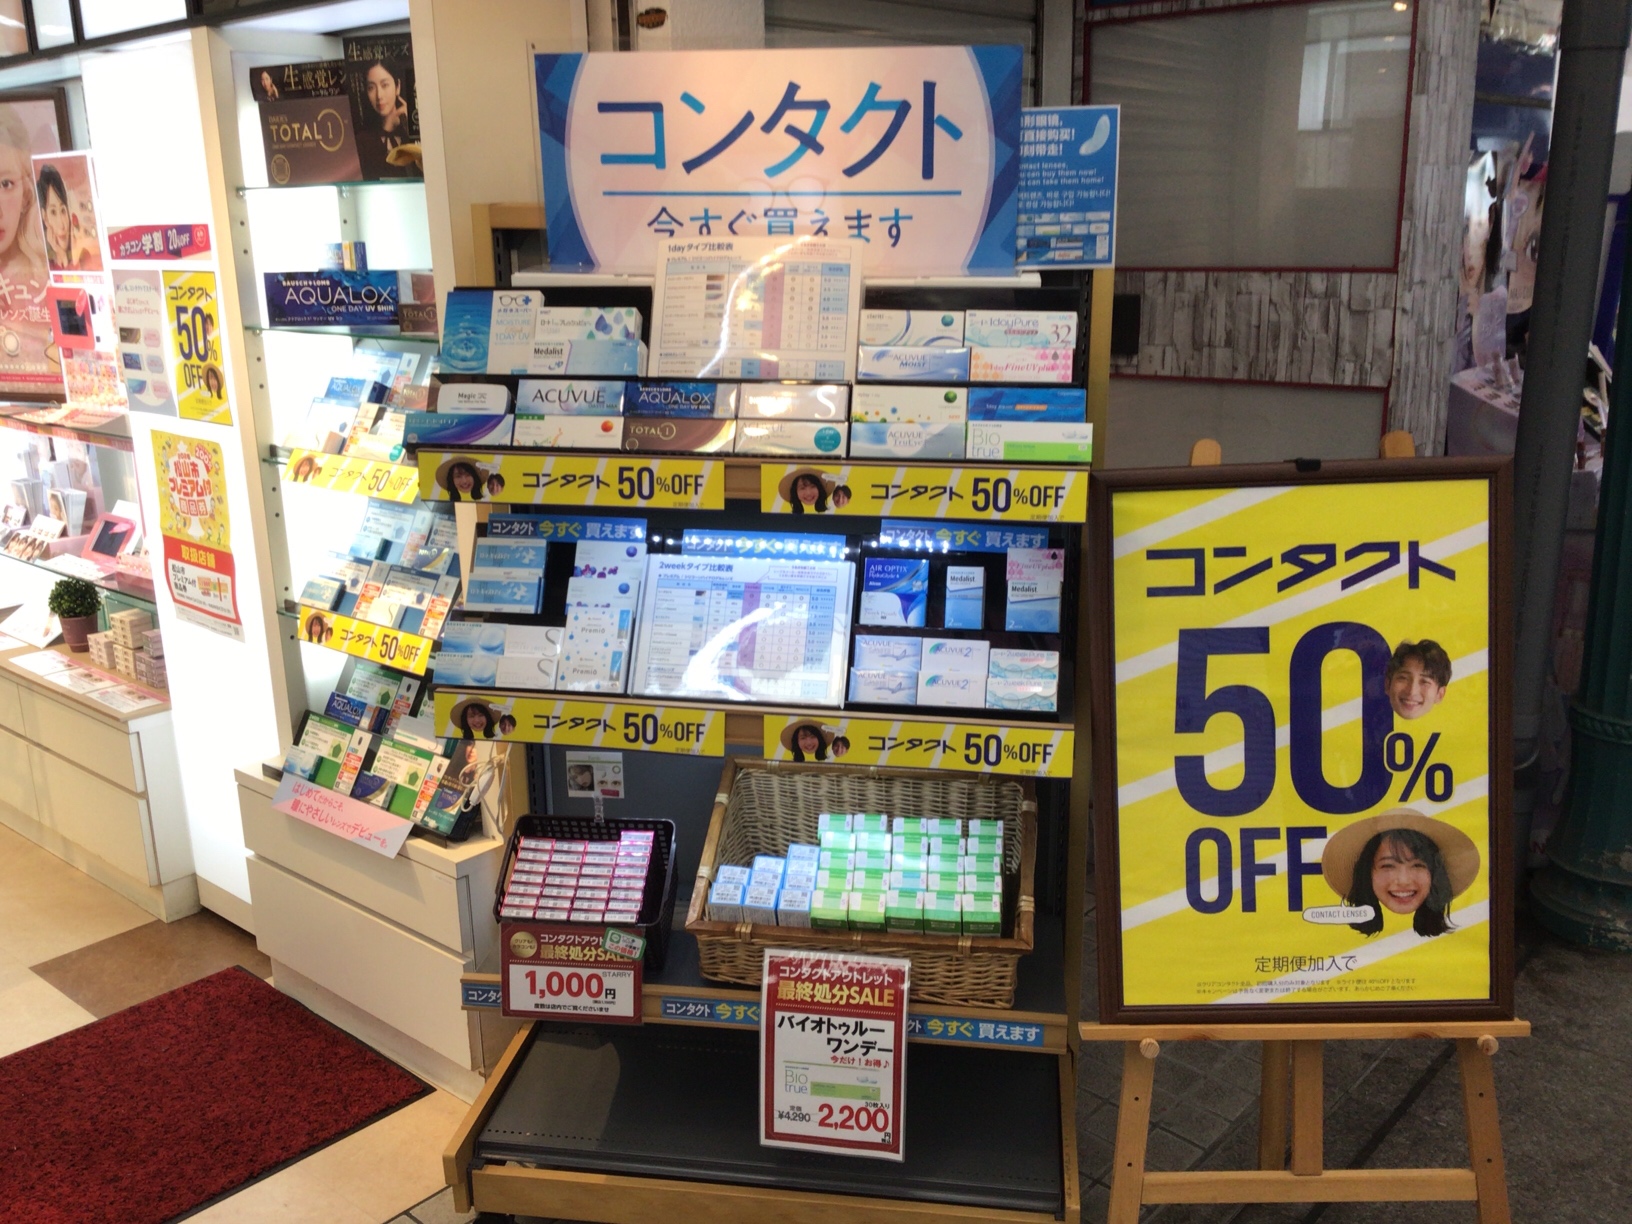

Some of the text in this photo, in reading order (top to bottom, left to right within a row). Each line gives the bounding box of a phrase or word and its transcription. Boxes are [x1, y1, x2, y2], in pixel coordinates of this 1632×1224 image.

[597, 80, 963, 181] コンタクト
[647, 205, 914, 248] 今すぐ買えます
[169, 286, 213, 301] コンタクト
[285, 286, 394, 305] AQUALOX
[331, 305, 394, 313] ONE DAY UV SHIN
[533, 347, 563, 356] Medalist
[458, 392, 476, 400] Magic
[532, 388, 605, 409] ACUVUE
[638, 392, 711, 404] AQUALOX
[972, 428, 1001, 445] Bio
[971, 445, 1000, 457] true
[174, 459, 200, 479] 松山市
[328, 466, 368, 482] コンタクト
[523, 471, 610, 490] コンタクト
[870, 483, 963, 501] コンタクト
[492, 521, 643, 540] コンタクト 今すぐ 買えます
[883, 528, 1046, 549] コンタクト 今すぐ 買えます
[181, 544, 216, 569] 取扱店舗
[869, 565, 907, 573] AIR OPTIX
[1146, 540, 1456, 598] コンタクト
[950, 575, 975, 583] Medalist
[1011, 585, 1037, 593] Medalist
[340, 628, 378, 648] コンタクト
[534, 714, 616, 733] コンタクト
[868, 735, 956, 755] コンタクト
[1185, 826, 1328, 914] OFF
[1311, 908, 1368, 919] CONTACT LENSES
[1254, 954, 1358, 974] 定期便加入で
[601, 971, 632, 979] STARRY
[779, 965, 893, 986] コンタクトアウトレット
[525, 970, 616, 1000] 1,000 円
[777, 979, 895, 1008] 最終処分SALE
[666, 1002, 711, 1017] コンタクト
[777, 1015, 886, 1036] バイオトゥルー
[927, 1019, 975, 1037] 今すぐ
[978, 1022, 1040, 1042] 買えます
[827, 1037, 893, 1056] ワンデー
[785, 1069, 808, 1084] Bio
[784, 1084, 808, 1094] true
[818, 1103, 889, 1133] 2,200
